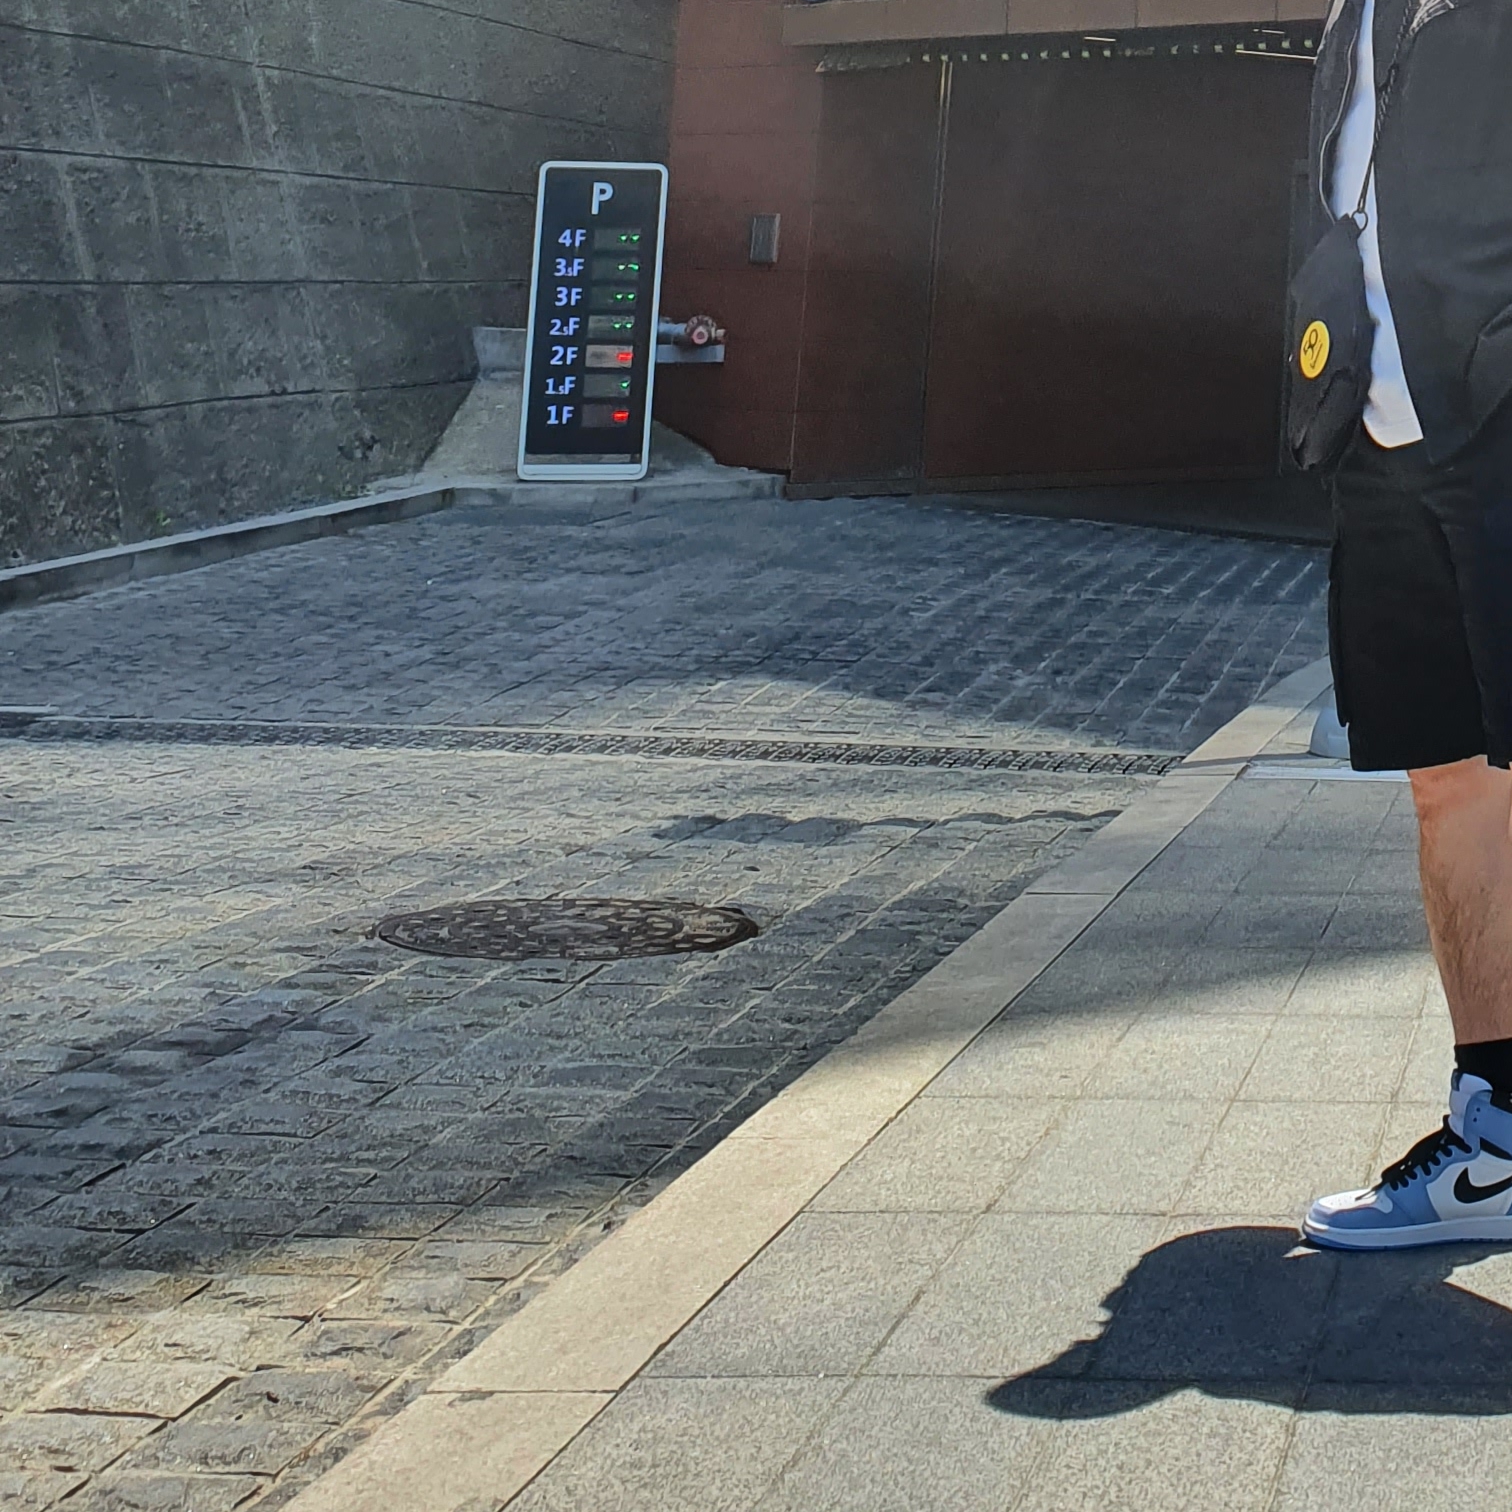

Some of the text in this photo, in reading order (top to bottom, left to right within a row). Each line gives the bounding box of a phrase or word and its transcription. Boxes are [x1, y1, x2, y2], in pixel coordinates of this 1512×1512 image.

[590, 181, 613, 215] P
[558, 228, 586, 247] 4F
[554, 287, 582, 306] 3F
[550, 346, 578, 365] 2F
[546, 405, 574, 425] 1F
